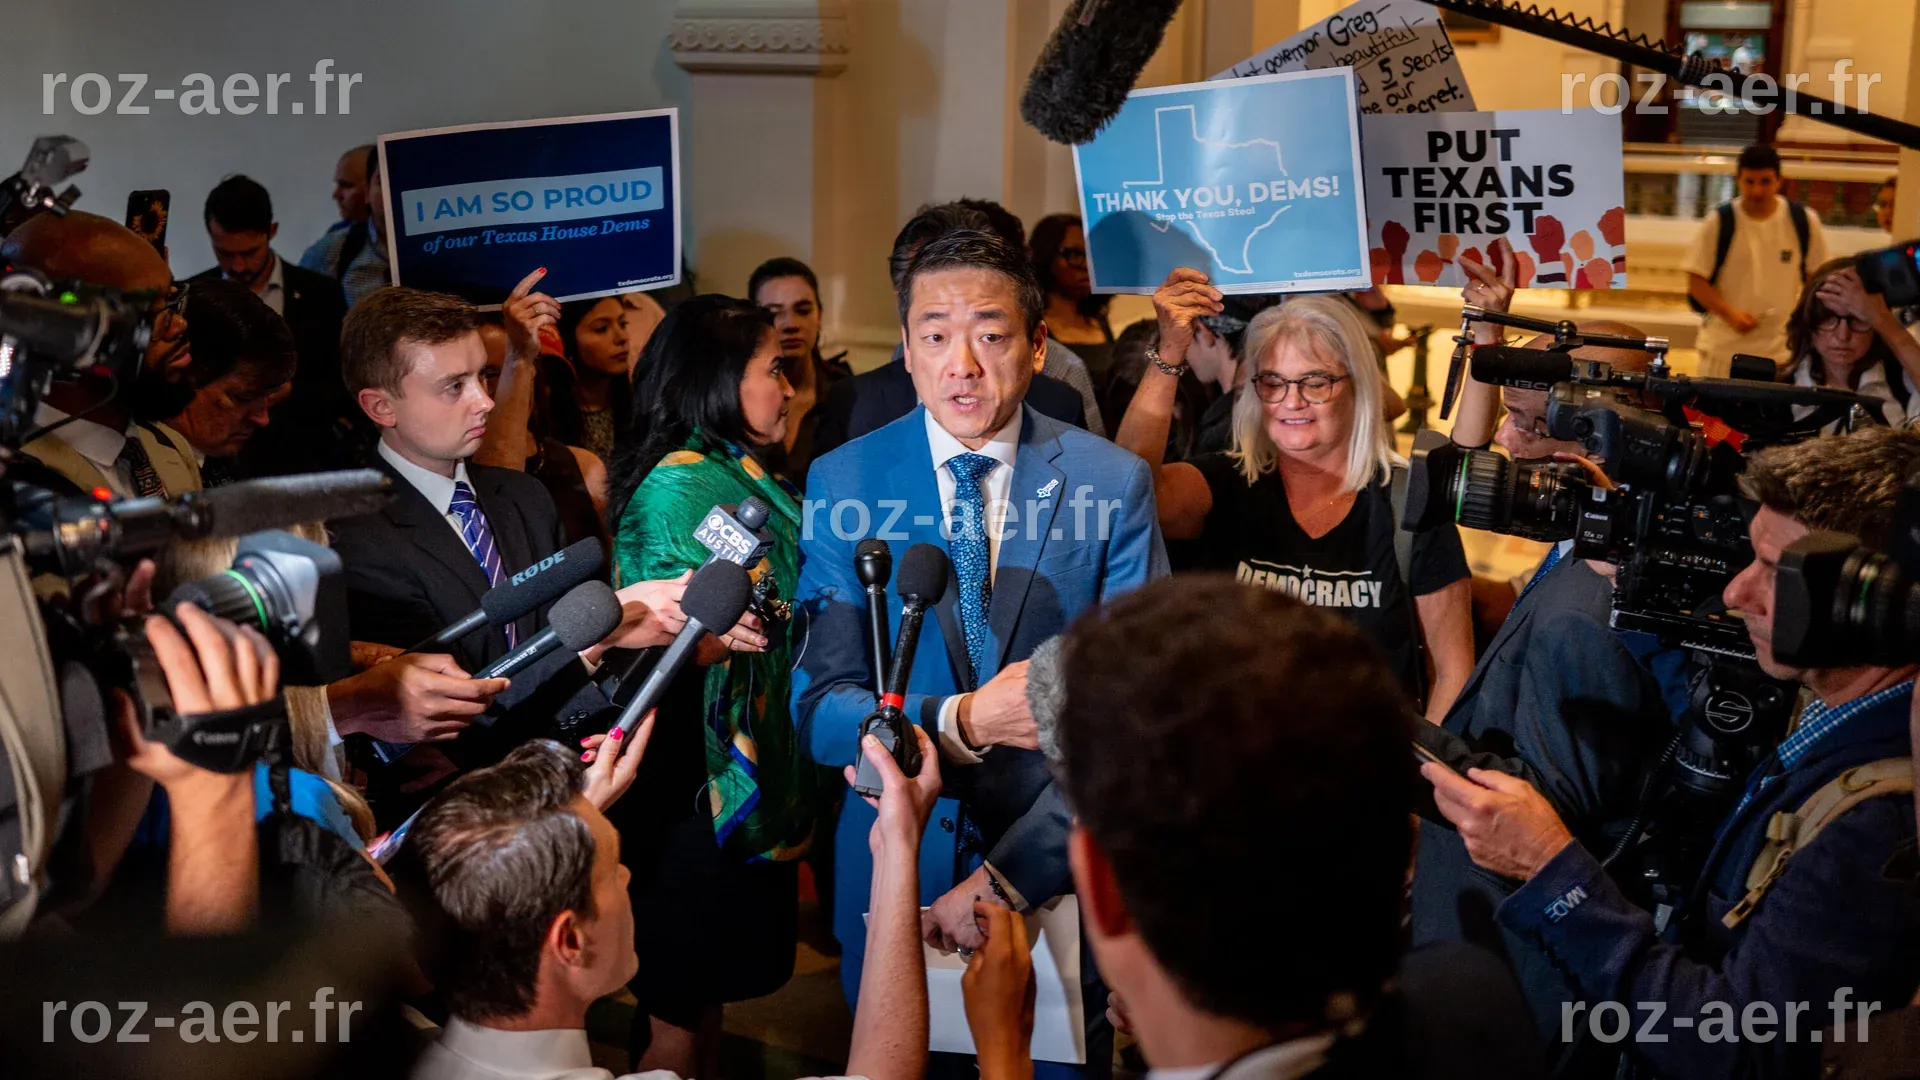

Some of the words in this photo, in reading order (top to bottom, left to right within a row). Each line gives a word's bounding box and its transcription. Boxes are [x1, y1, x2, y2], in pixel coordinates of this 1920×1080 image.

[1378, 57, 1394, 84] 5
[1386, 81, 1415, 107] our
[1394, 78, 1465, 114] ecret.
[1427, 129, 1520, 163] PUT
[1092, 189, 1169, 213] THANK
[1173, 183, 1243, 210] YOU,
[1249, 175, 1340, 204] DEMS!
[1382, 164, 1575, 199] TEXANS
[416, 201, 424, 222] I
[434, 193, 483, 221] AM
[491, 189, 535, 213] SO
[544, 179, 653, 210] PROUD
[1155, 212, 1177, 223] Stop
[1178, 210, 1194, 221] the
[1195, 208, 1226, 220] Texas
[1227, 206, 1255, 217] Steal
[1414, 201, 1543, 235] FIRST
[423, 234, 446, 255] of
[444, 235, 478, 249] our
[482, 227, 538, 245] Texas
[540, 223, 598, 242] House
[600, 217, 650, 235] Dems
[617, 273, 675, 288] txdemocrats.org
[1293, 267, 1362, 279] txdemocrats.org
[698, 528, 743, 564] AUSTIN
[719, 524, 752, 555] CBS
[1235, 560, 1383, 608] DEMOCRACY
